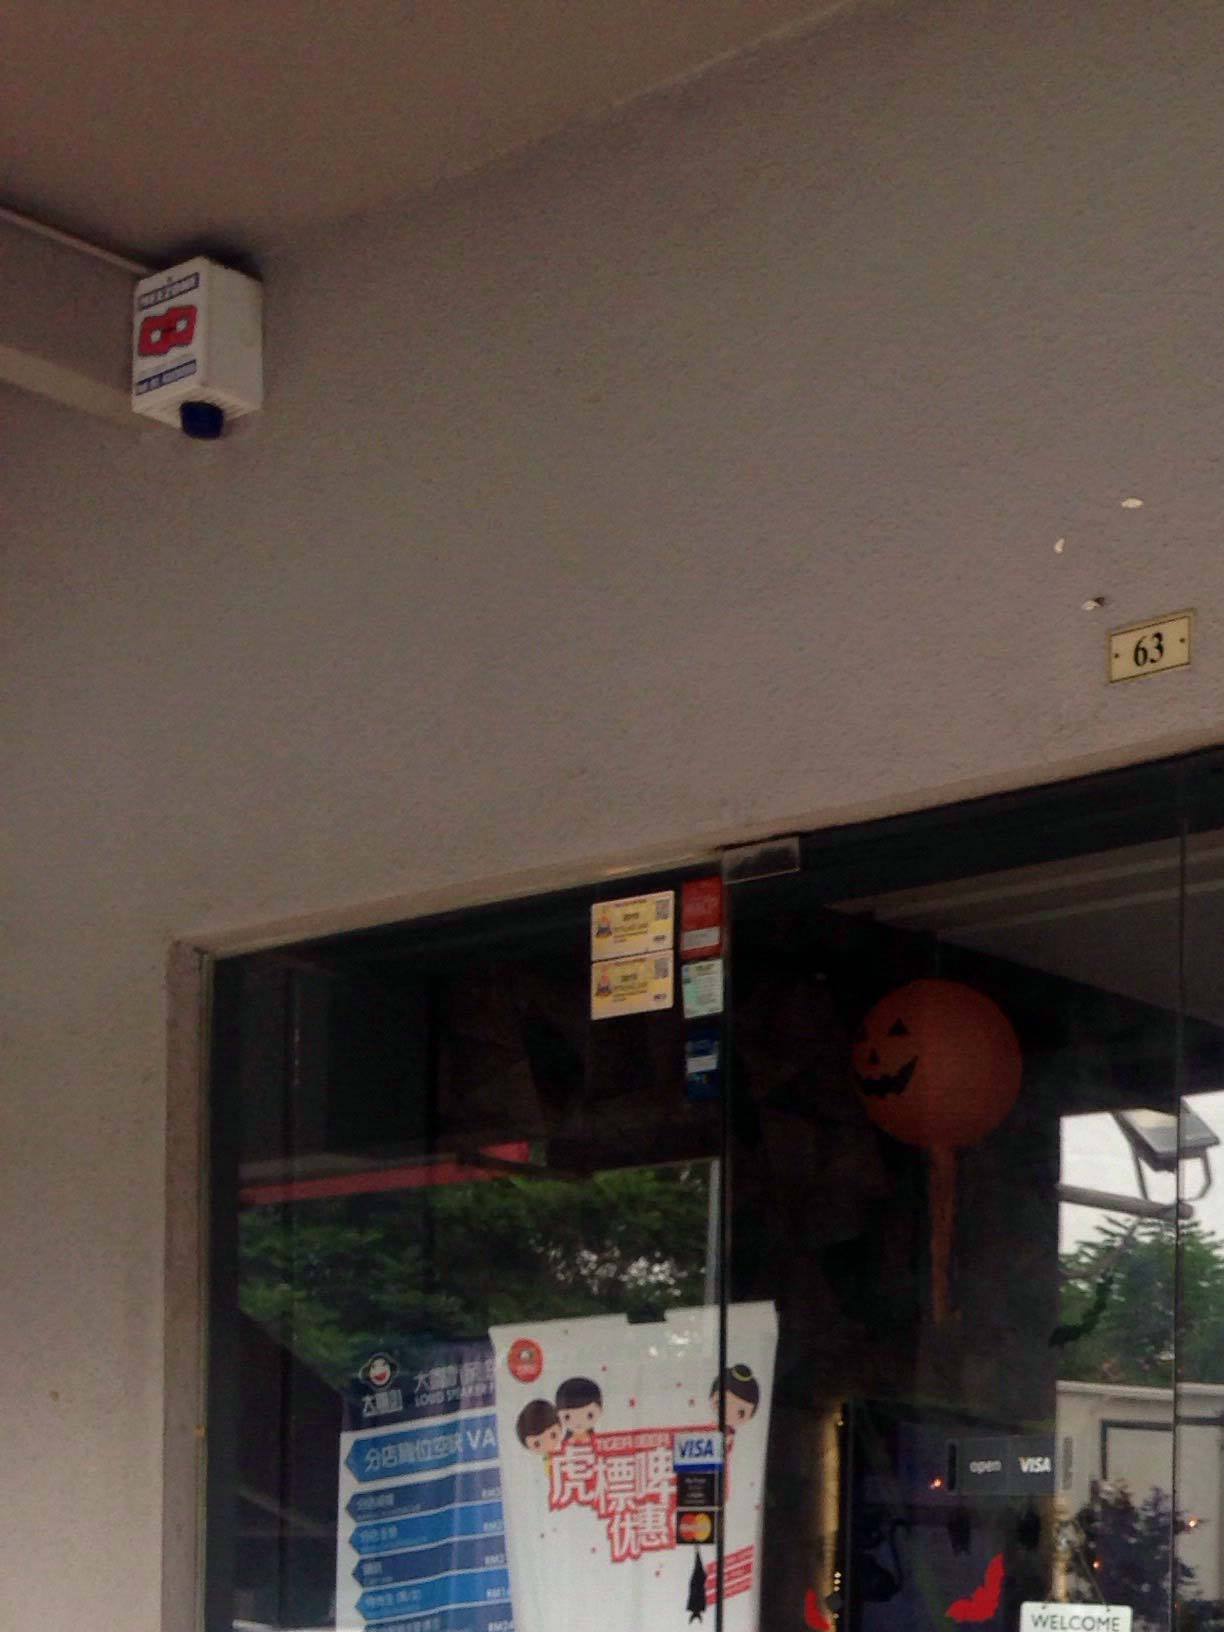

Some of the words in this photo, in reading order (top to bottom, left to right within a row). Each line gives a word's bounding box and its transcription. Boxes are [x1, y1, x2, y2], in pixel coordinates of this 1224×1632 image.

[1134, 632, 1164, 667] 63
[680, 1439, 714, 1458] VISA
[1018, 1456, 1052, 1473] VISA
[550, 1445, 678, 1514] 虎標啤
[1031, 1614, 1121, 1632] WELCOME
